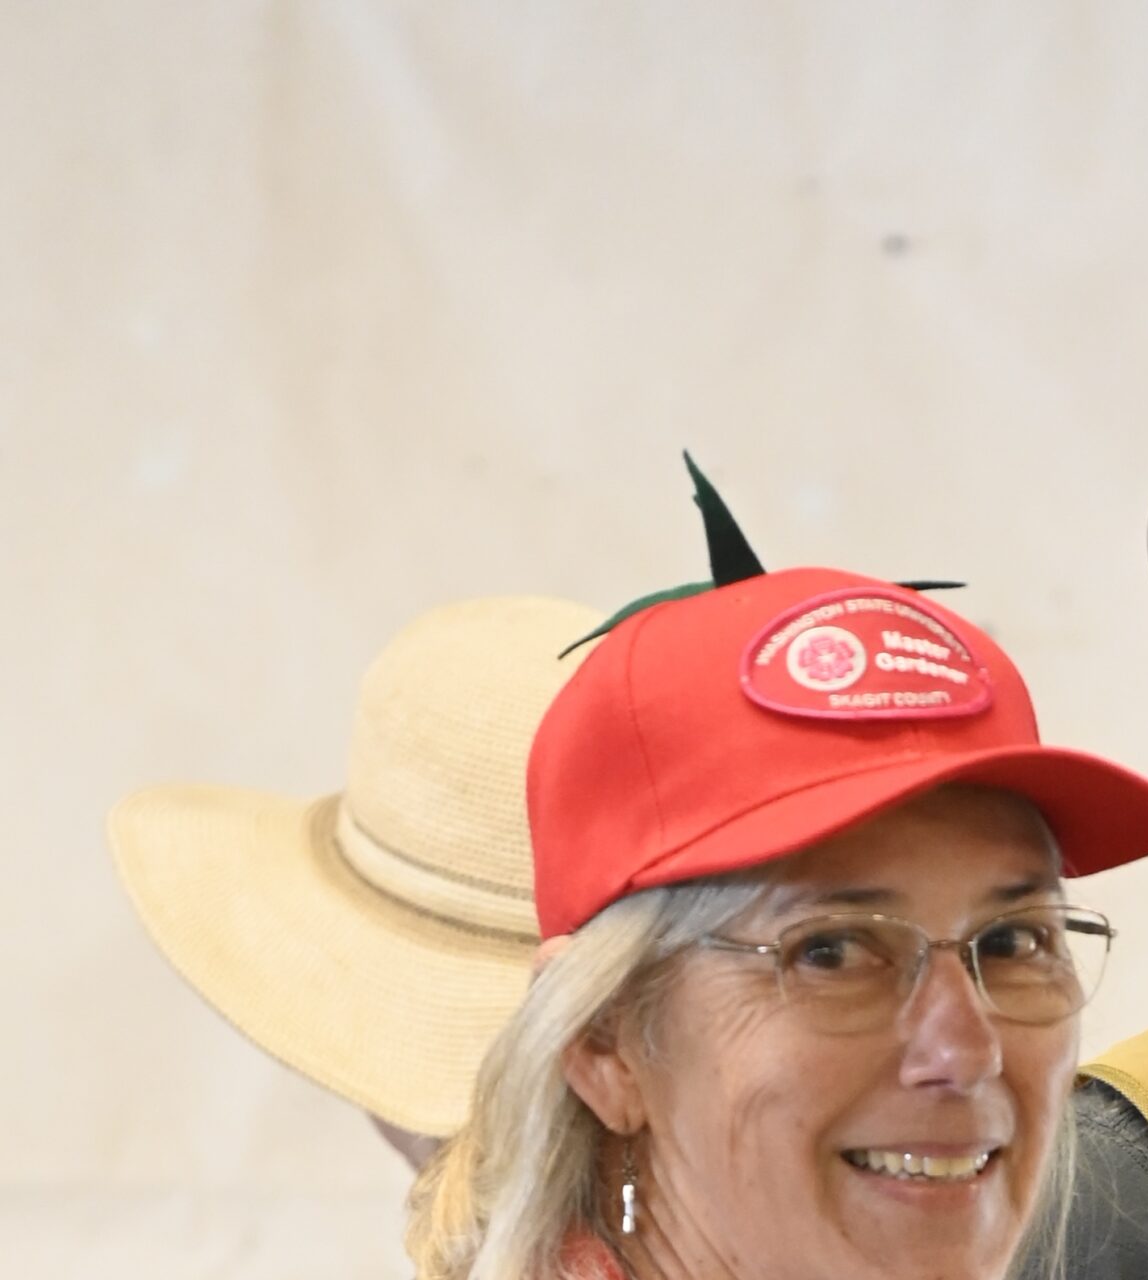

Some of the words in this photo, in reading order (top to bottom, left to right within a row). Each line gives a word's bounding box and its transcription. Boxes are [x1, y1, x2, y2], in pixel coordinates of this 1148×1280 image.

[755, 603, 844, 665] WASHINGTON
[846, 598, 893, 614] STATE
[881, 631, 950, 660] Master
[875, 652, 968, 685] Gardener
[829, 692, 890, 707] SKAGIT
[893, 691, 951, 706] COUNTY
